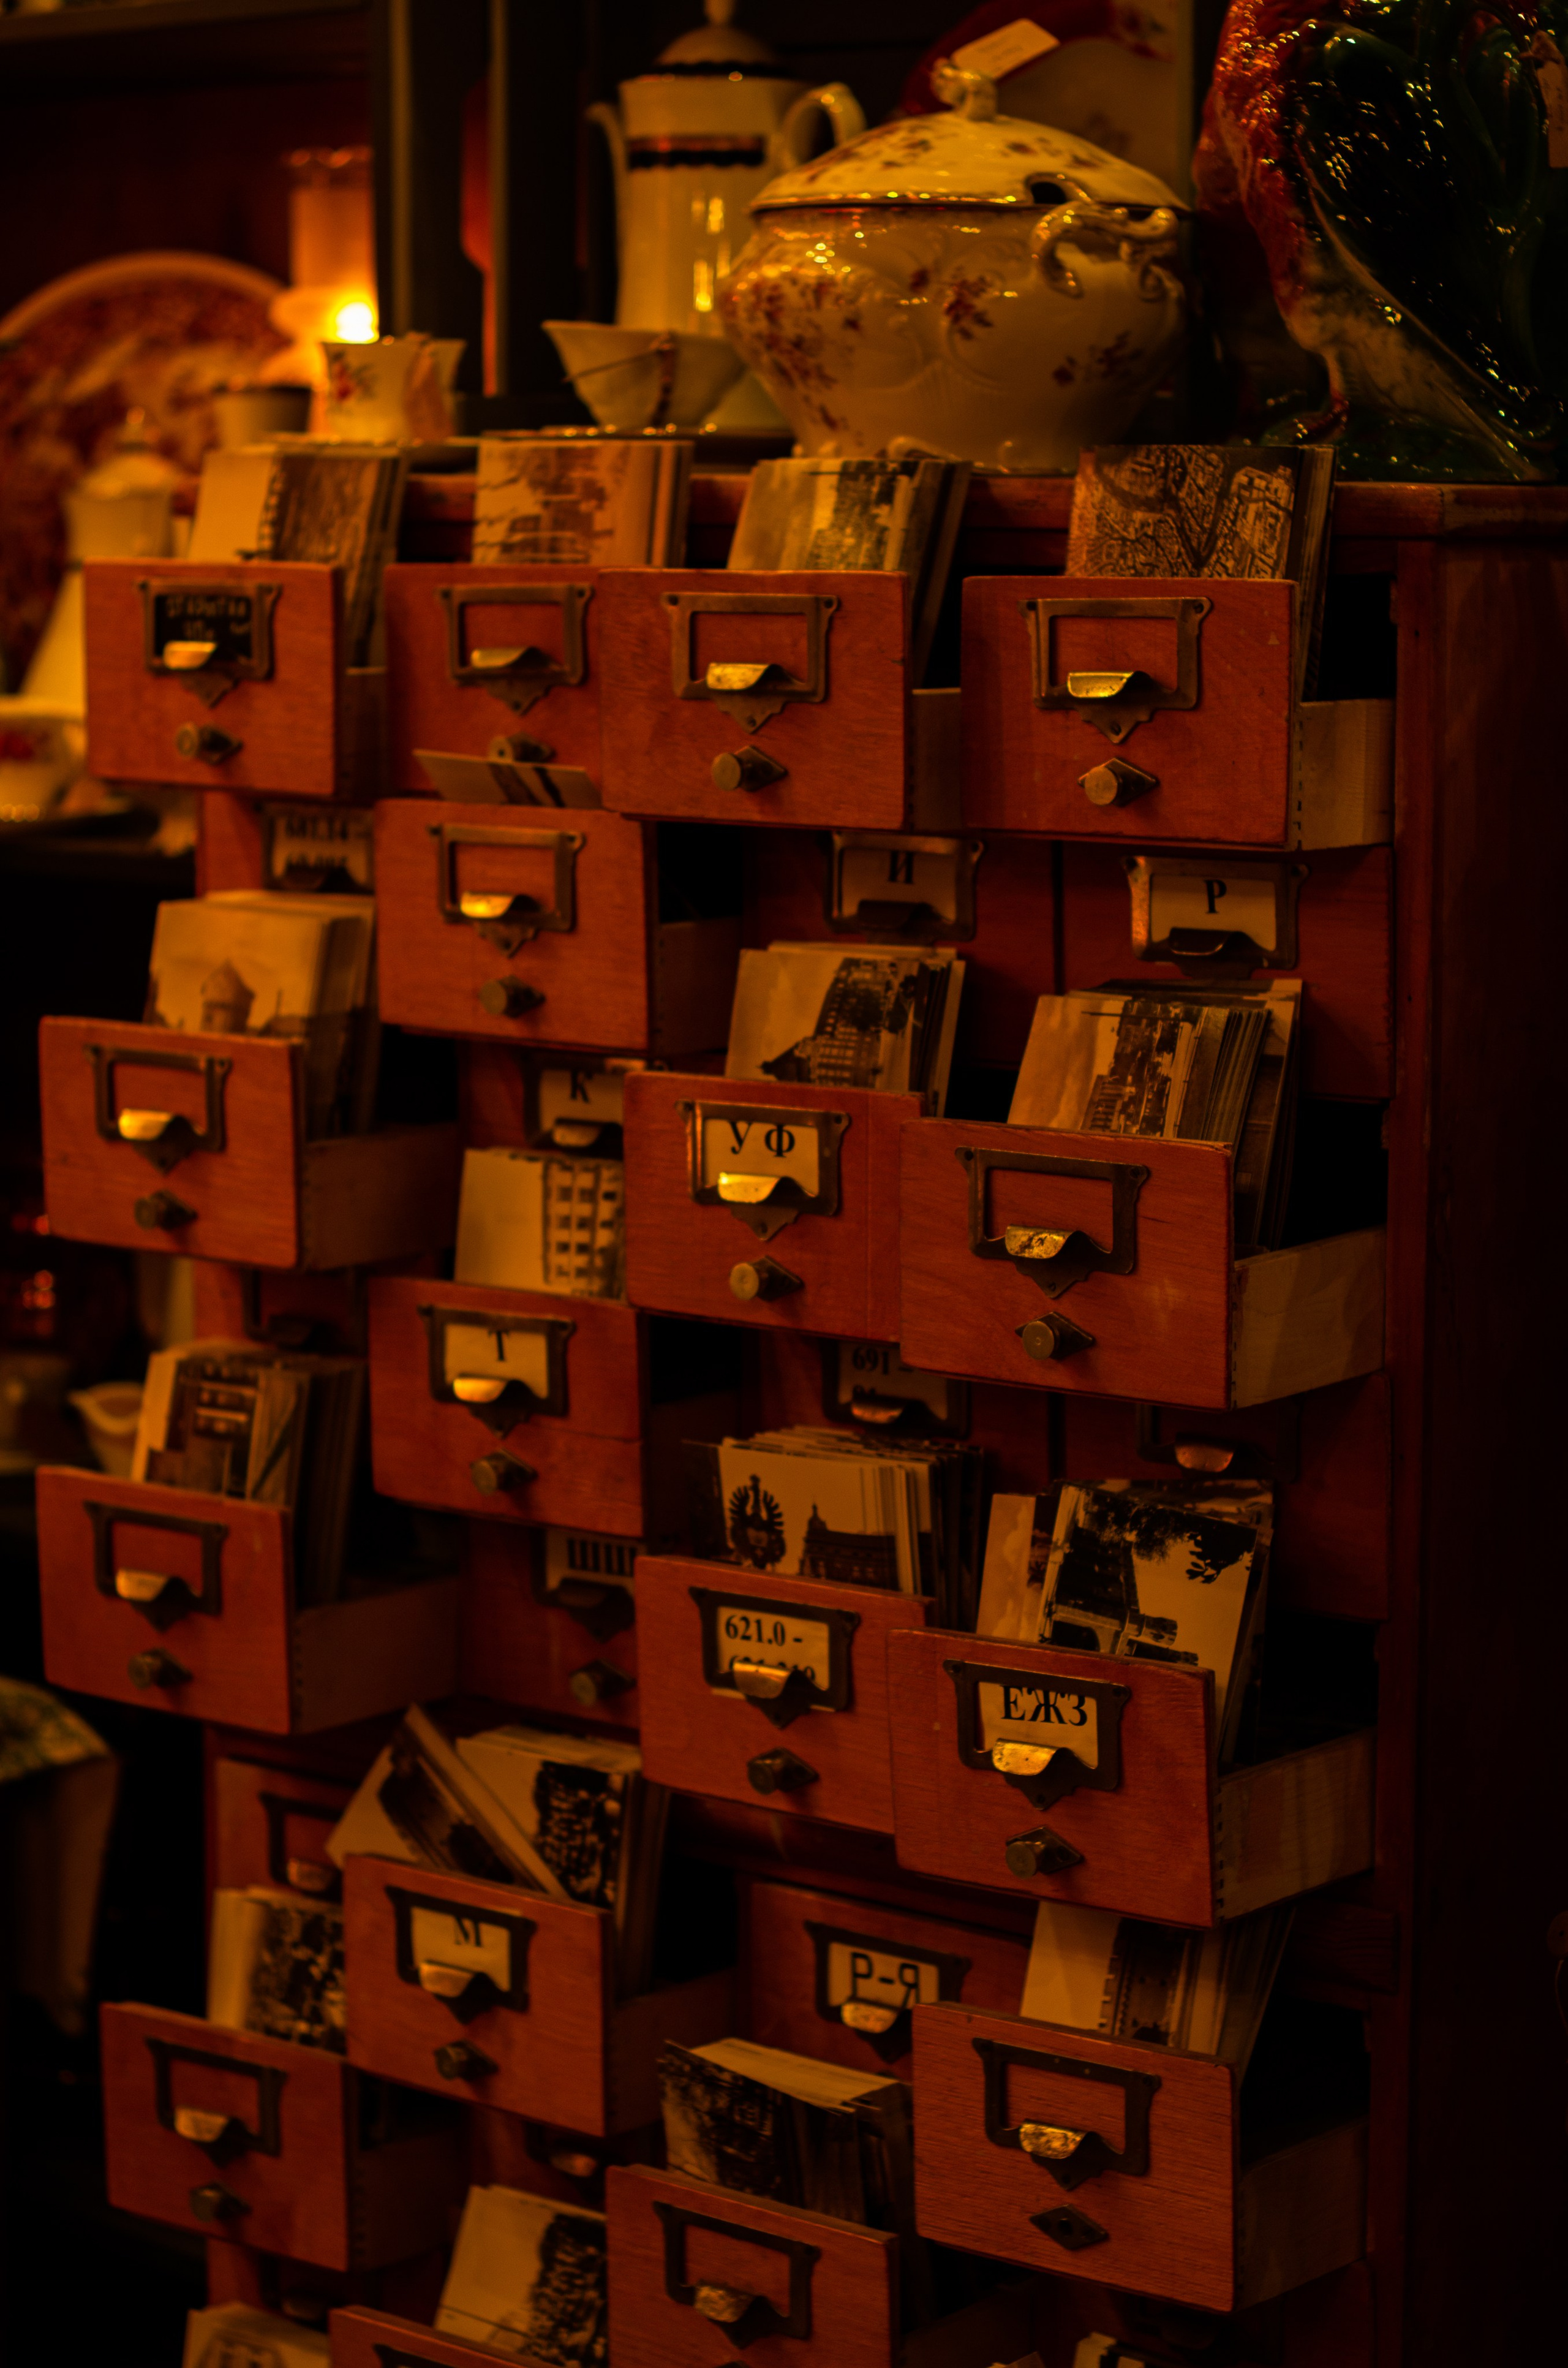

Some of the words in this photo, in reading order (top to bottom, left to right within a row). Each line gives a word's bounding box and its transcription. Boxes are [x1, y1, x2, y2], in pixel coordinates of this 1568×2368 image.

[889, 850, 914, 883] И
[1204, 879, 1227, 914] Р
[570, 1071, 593, 1103] К
[728, 1121, 753, 1155] У
[764, 1123, 796, 1158] Ф
[488, 1330, 511, 1361] Т
[853, 1347, 889, 1375] 691
[725, 1614, 786, 1647] 621.0
[1000, 1685, 1088, 1727] ЕЖЗ
[454, 1915, 485, 1948] М
